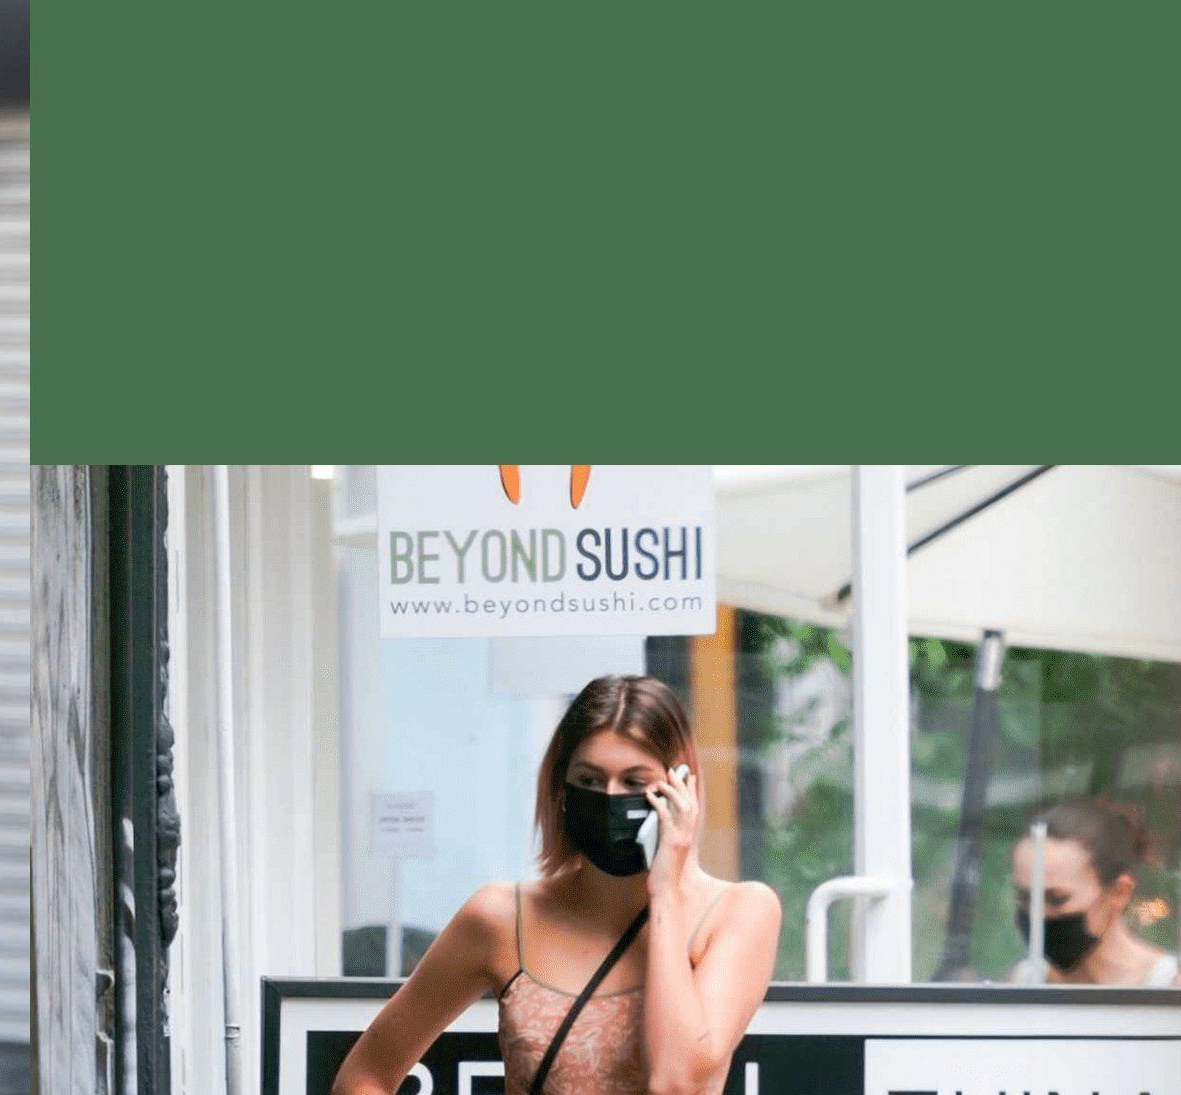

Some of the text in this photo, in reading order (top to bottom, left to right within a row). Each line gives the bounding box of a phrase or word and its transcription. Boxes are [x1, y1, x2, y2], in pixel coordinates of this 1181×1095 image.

[389, 526, 703, 584] BEYOND SUSHI
[390, 592, 704, 619] www.beyondsushi.com
